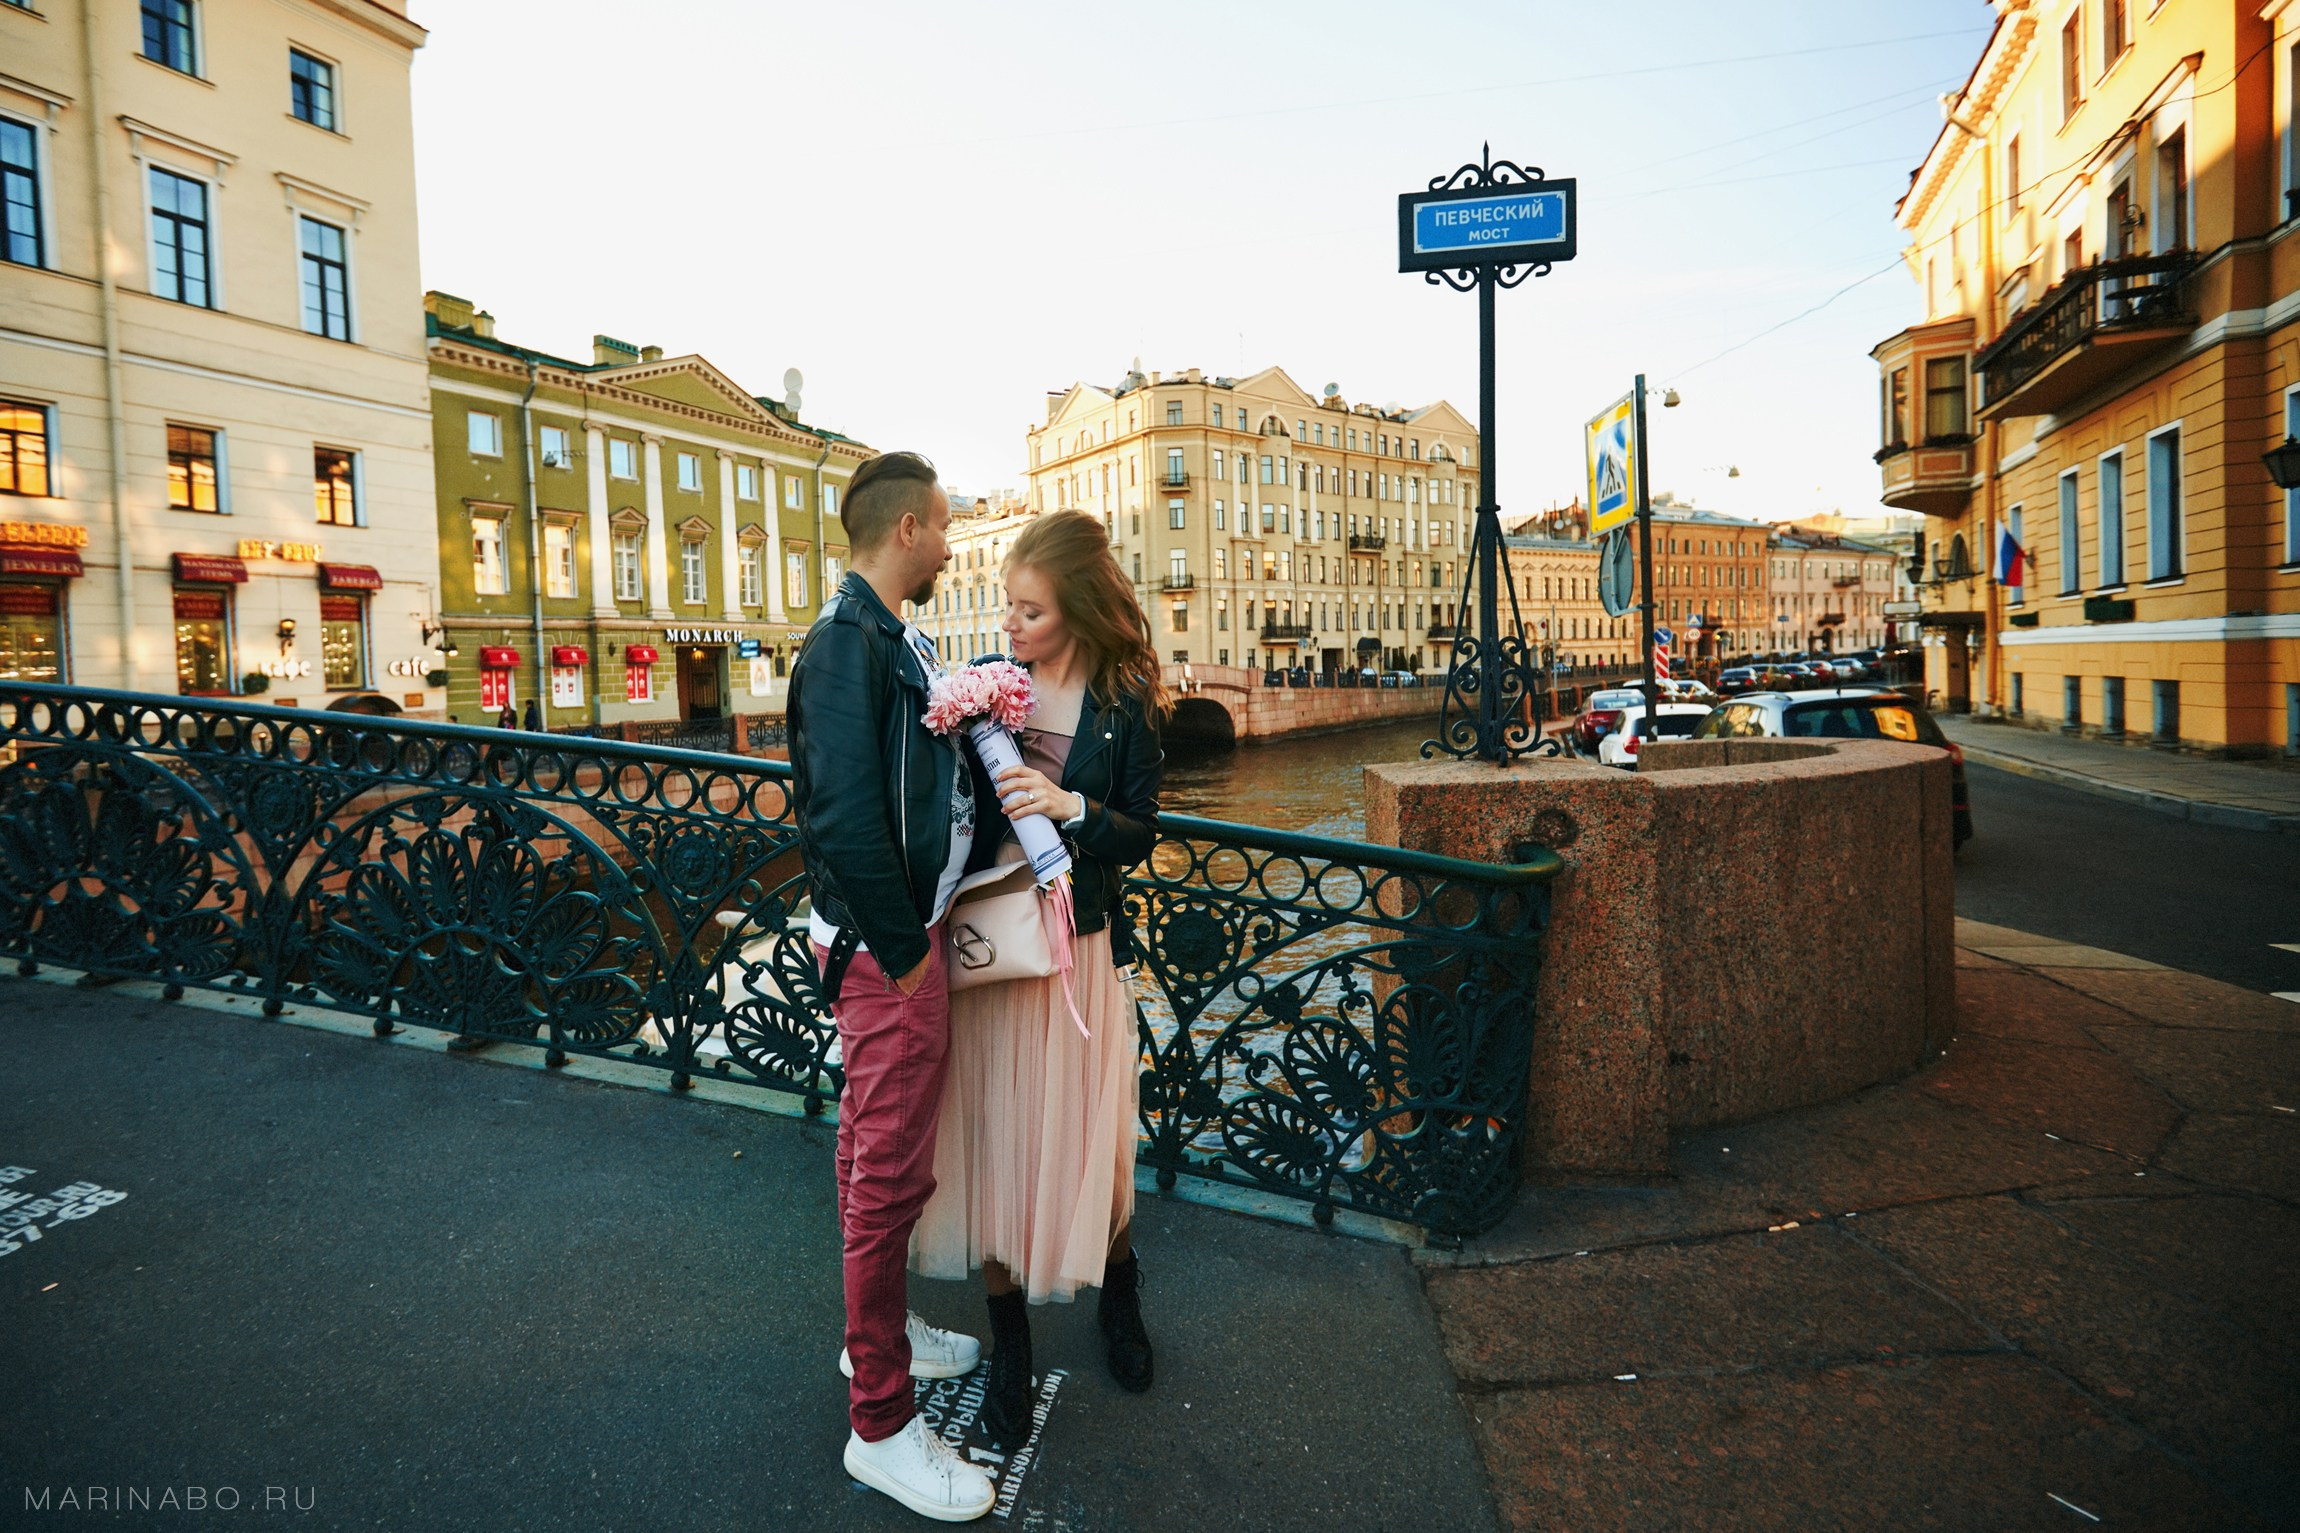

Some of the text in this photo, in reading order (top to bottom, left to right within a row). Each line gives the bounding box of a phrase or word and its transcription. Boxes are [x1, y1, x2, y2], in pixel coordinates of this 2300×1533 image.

[1435, 198, 1544, 227] ПЕВЧЕСКИЙ
[4, 559, 81, 573] JEWELRY
[665, 628, 743, 643] MONARCH
[389, 655, 431, 677] cafe
